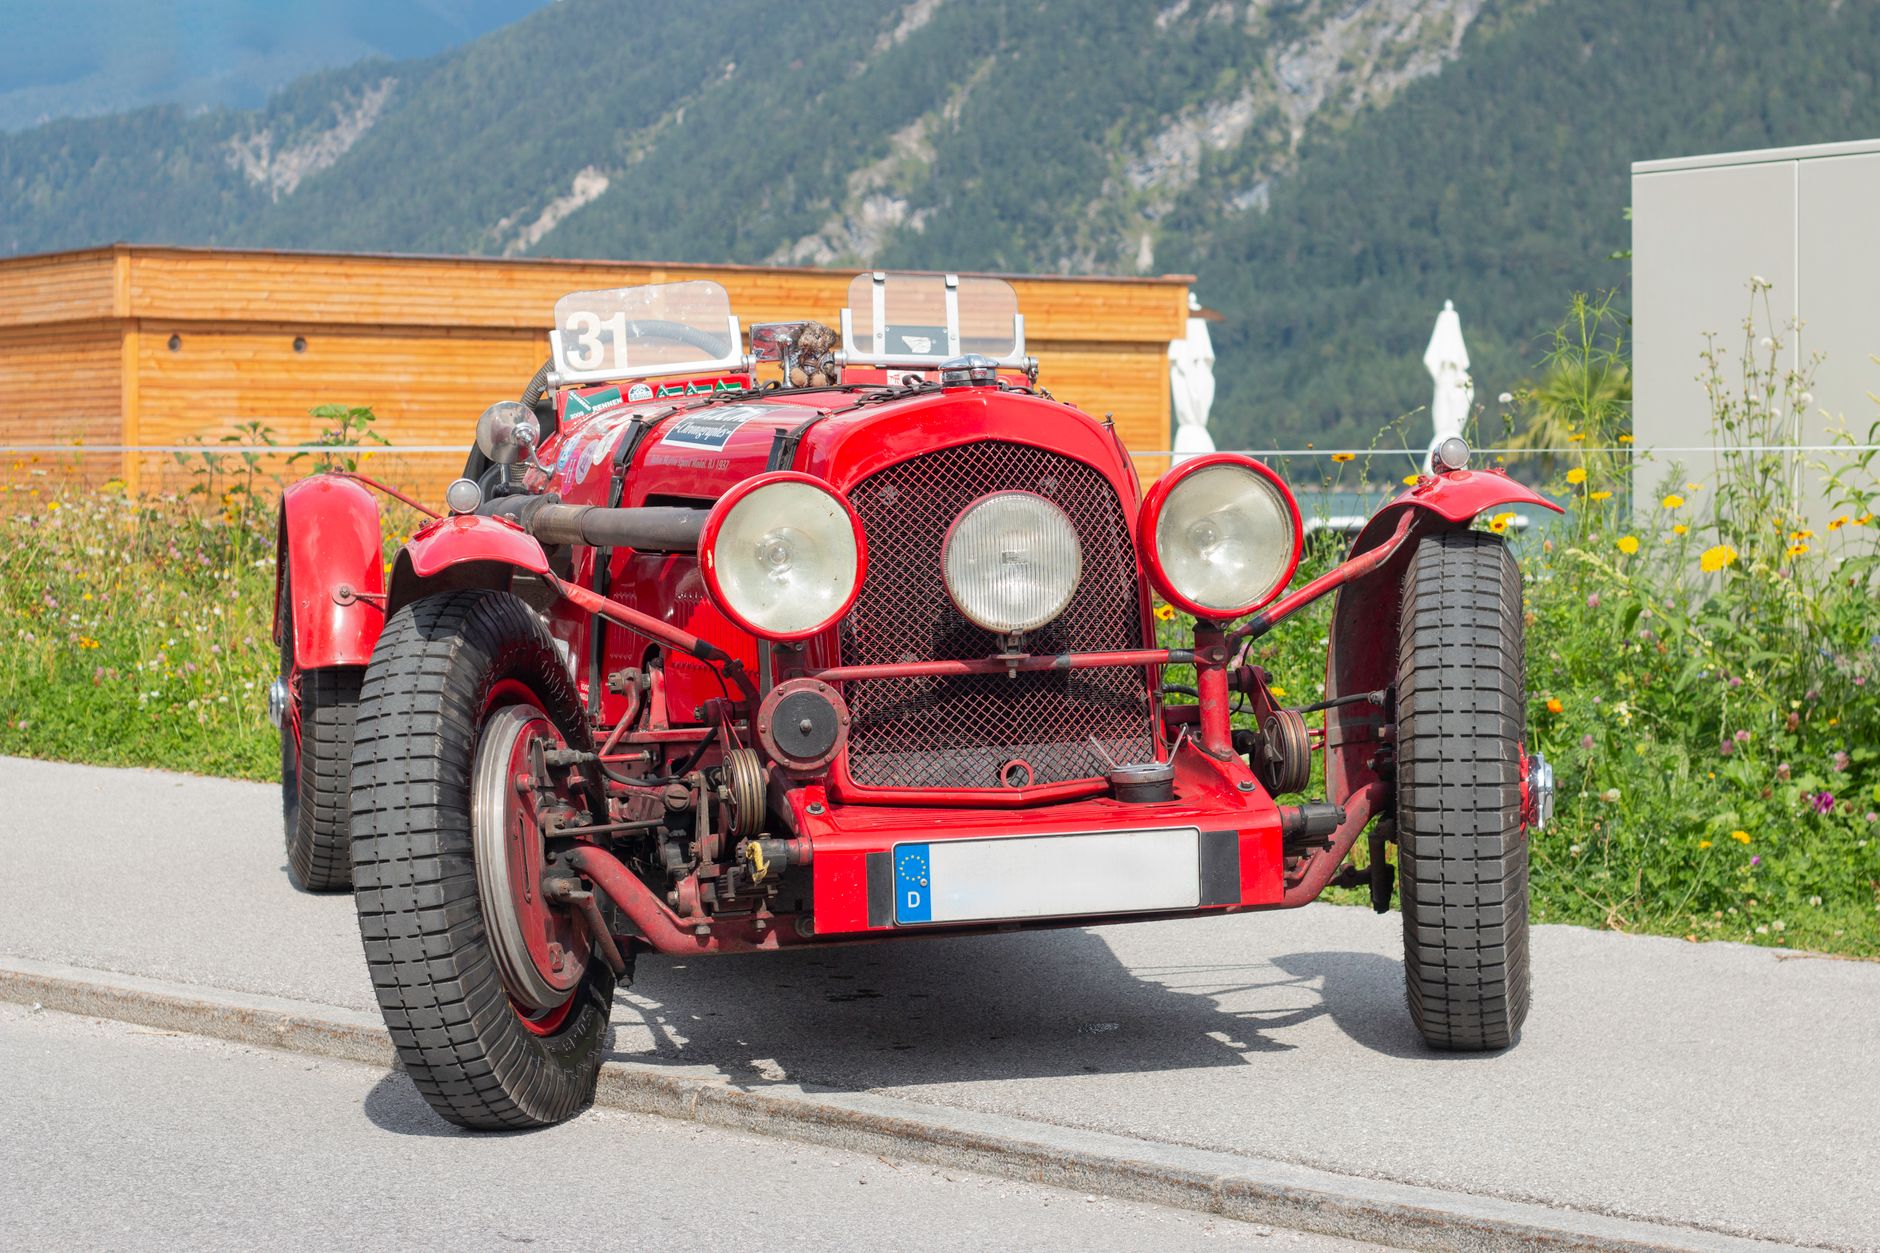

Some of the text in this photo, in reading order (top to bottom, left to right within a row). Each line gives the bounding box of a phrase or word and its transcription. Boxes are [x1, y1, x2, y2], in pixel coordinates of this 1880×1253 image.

[566, 311, 628, 370] 31
[592, 398, 624, 412] RENNEN
[907, 891, 921, 908] D
